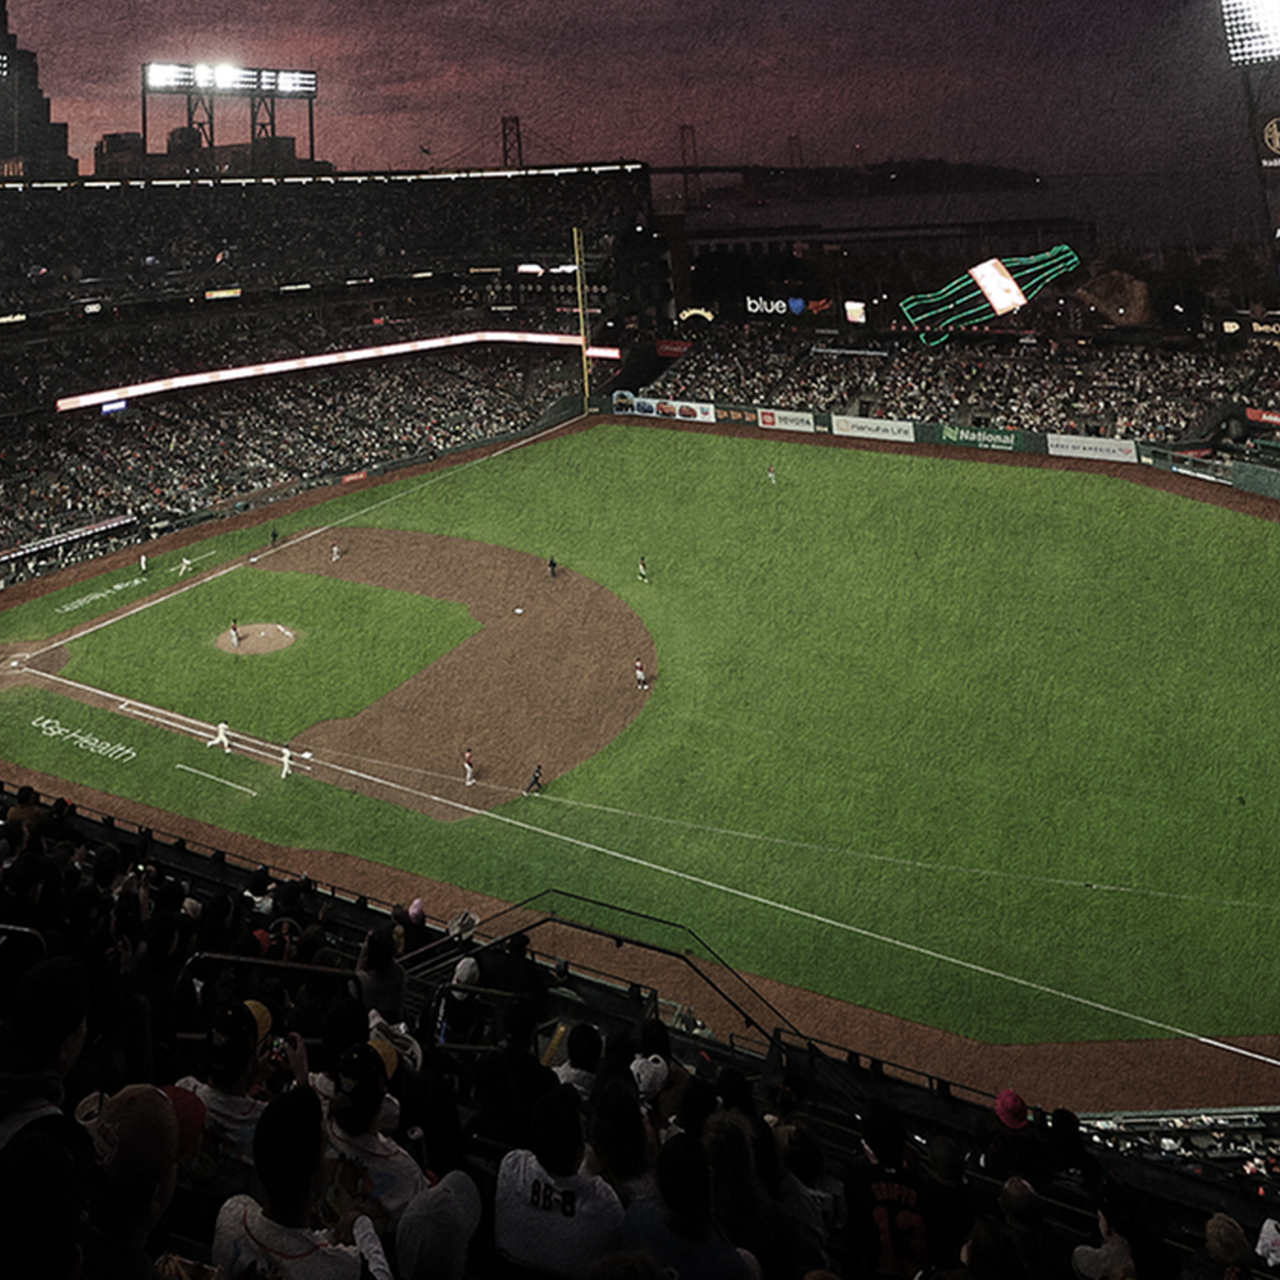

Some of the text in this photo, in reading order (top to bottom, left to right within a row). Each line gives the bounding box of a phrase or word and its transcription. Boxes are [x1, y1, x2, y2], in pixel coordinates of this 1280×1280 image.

[746, 295, 788, 315] blue
[959, 429, 1015, 445] National
[62, 728, 137, 764] Health
